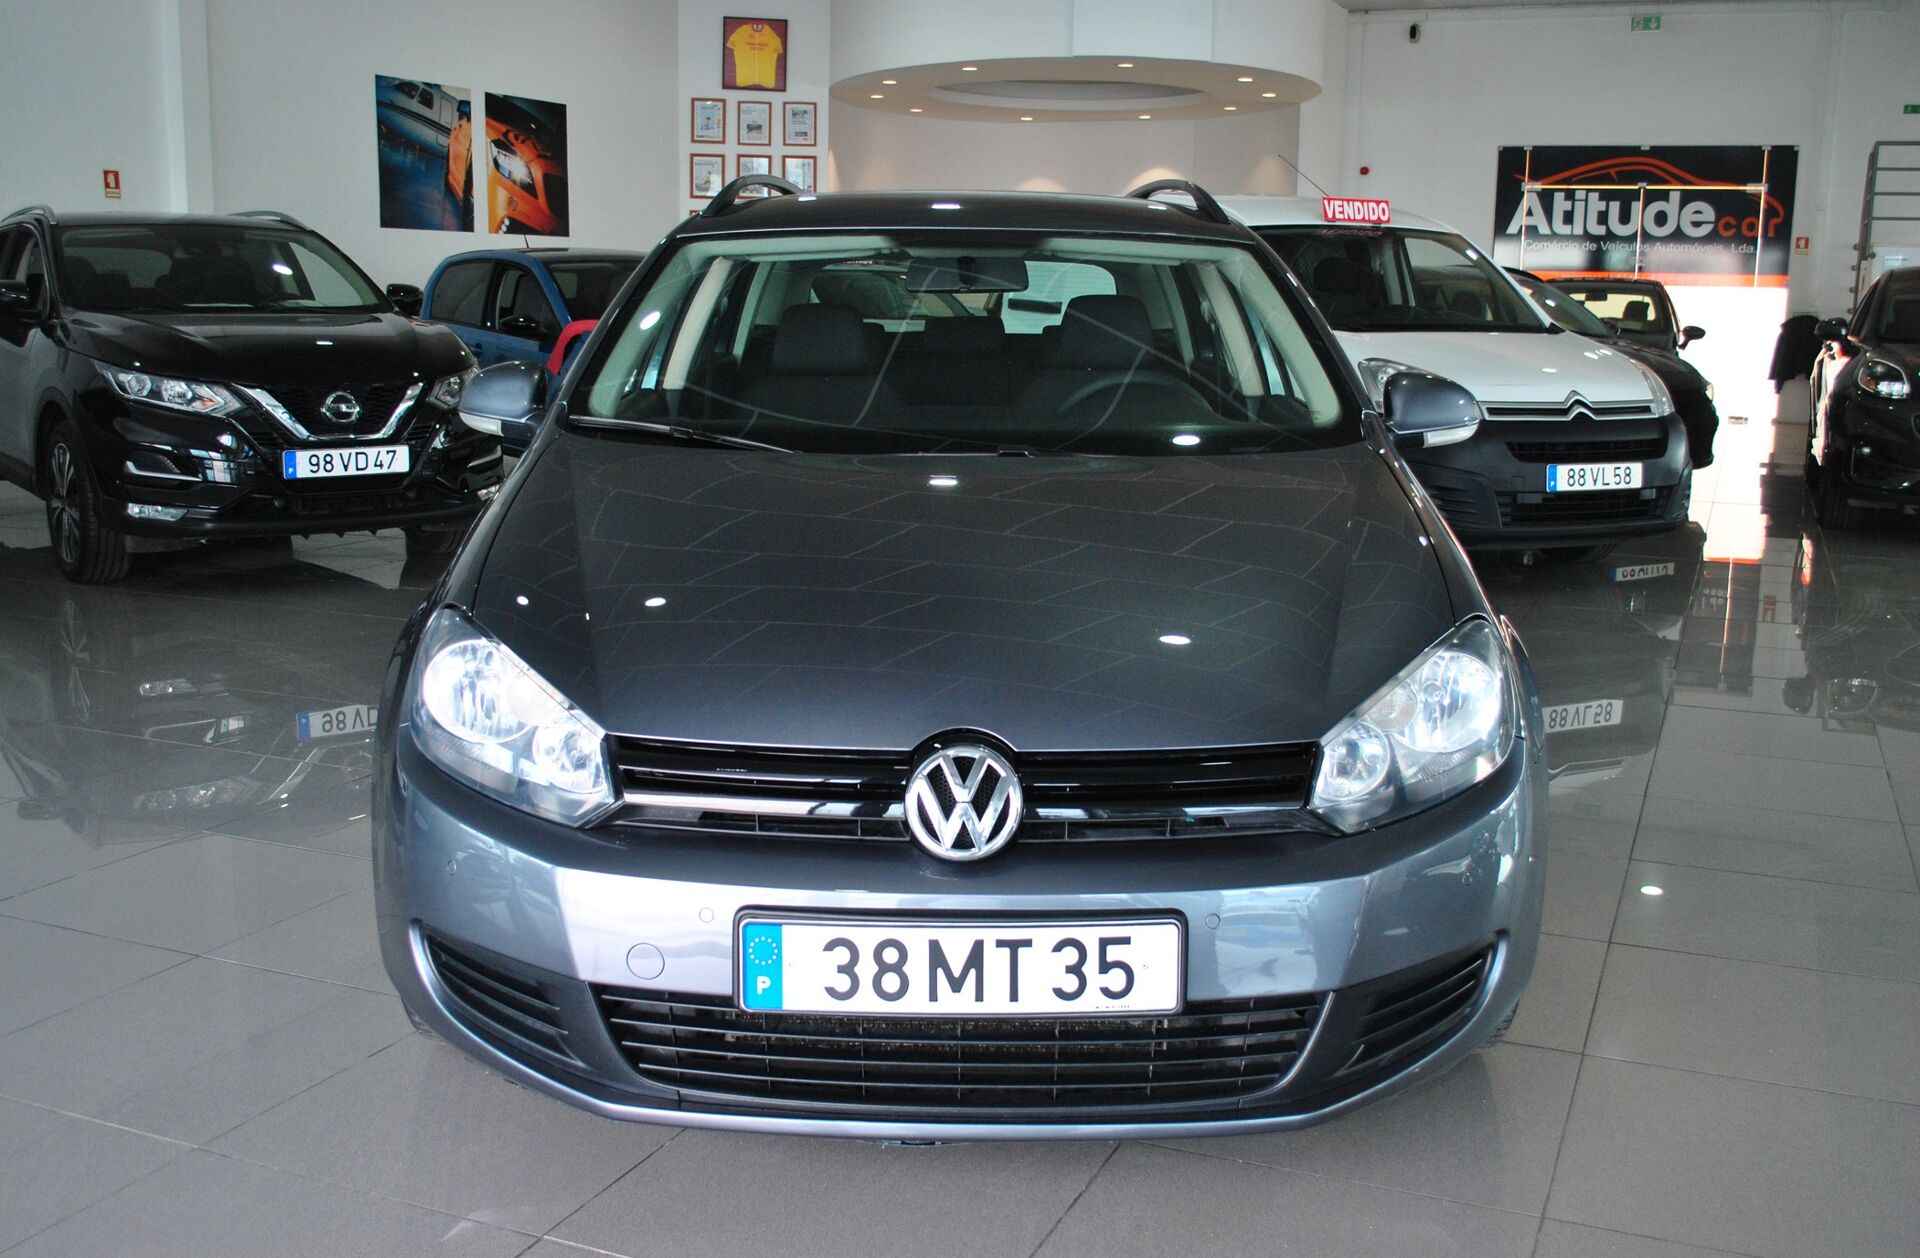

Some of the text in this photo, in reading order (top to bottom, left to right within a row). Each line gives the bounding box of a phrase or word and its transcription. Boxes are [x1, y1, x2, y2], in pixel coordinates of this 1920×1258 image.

[1323, 199, 1390, 222] VENDIDO
[1505, 190, 1716, 238] Atitude
[1524, 239, 1579, 250] Comércio
[1581, 241, 1598, 251] de
[756, 975, 771, 995] P
